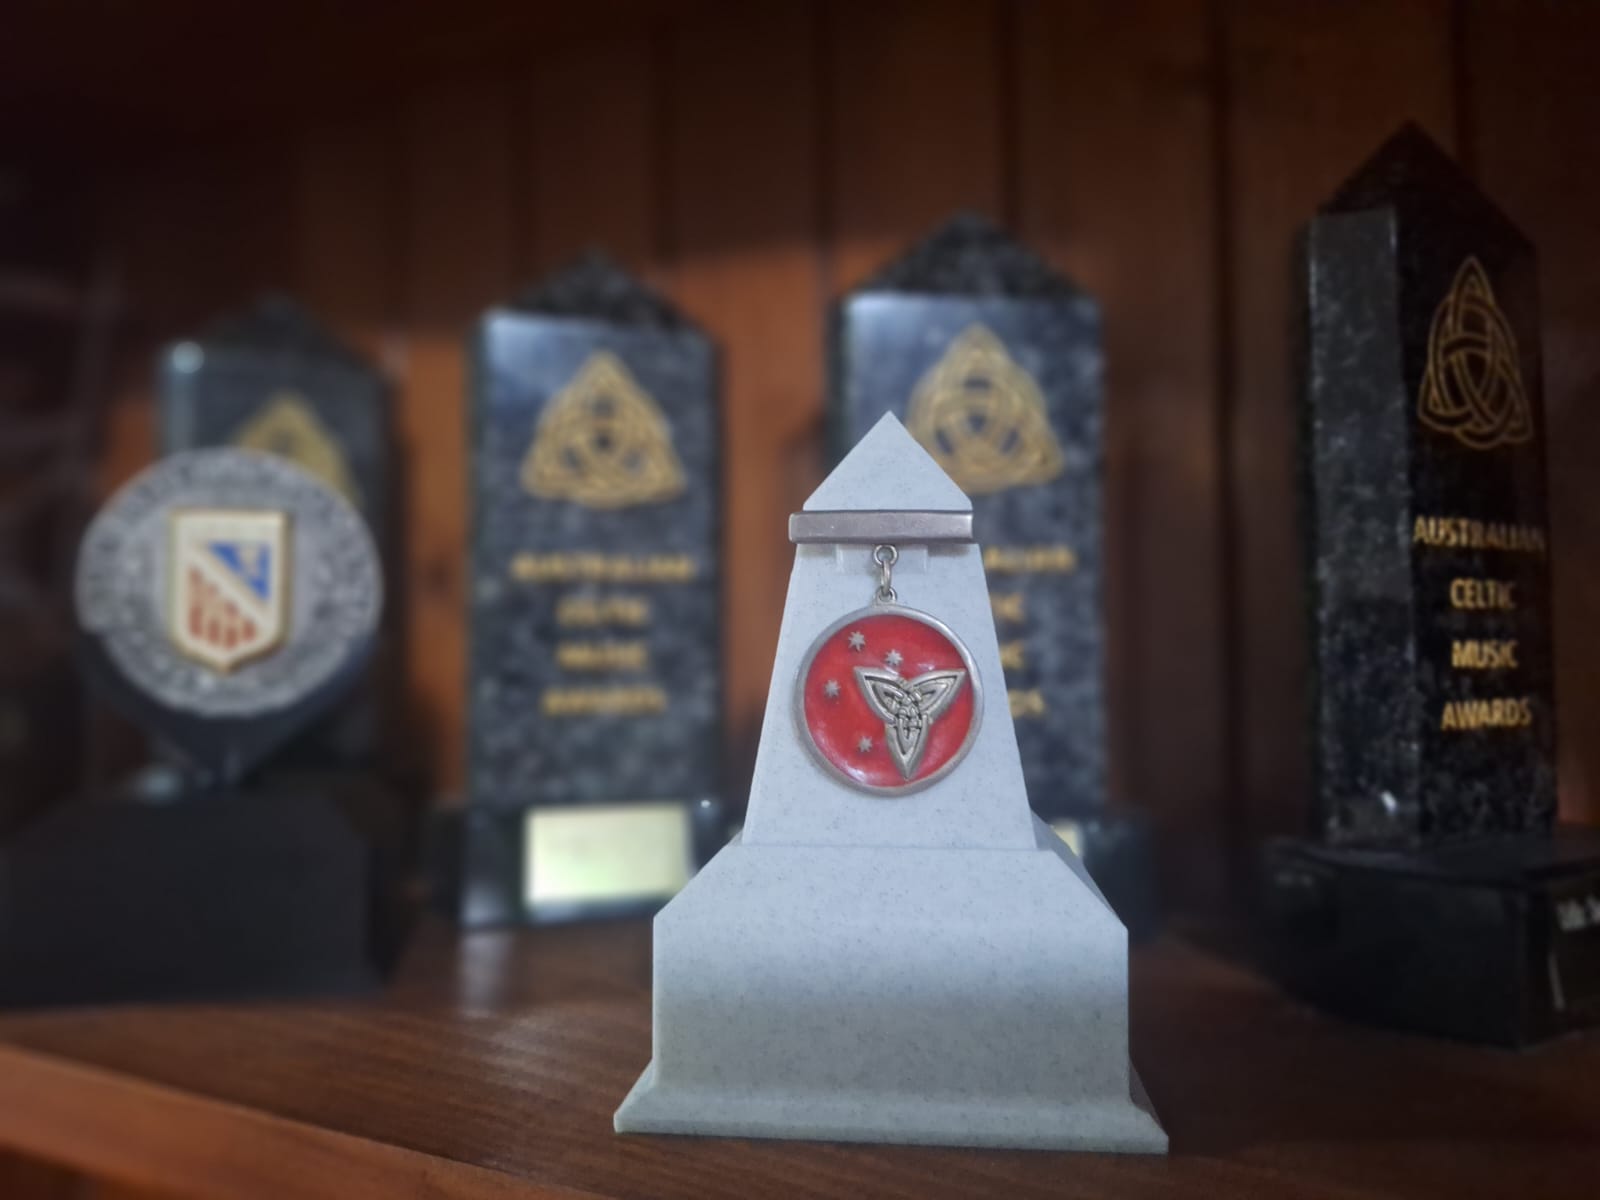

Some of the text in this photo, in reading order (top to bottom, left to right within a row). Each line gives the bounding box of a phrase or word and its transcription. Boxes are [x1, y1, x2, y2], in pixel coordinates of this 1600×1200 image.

[1413, 516, 1545, 550] AUSTRALIAN
[1450, 577, 1516, 609] CELTIC
[1452, 639, 1518, 668] MUSIC
[1441, 698, 1532, 731] AWARDS
